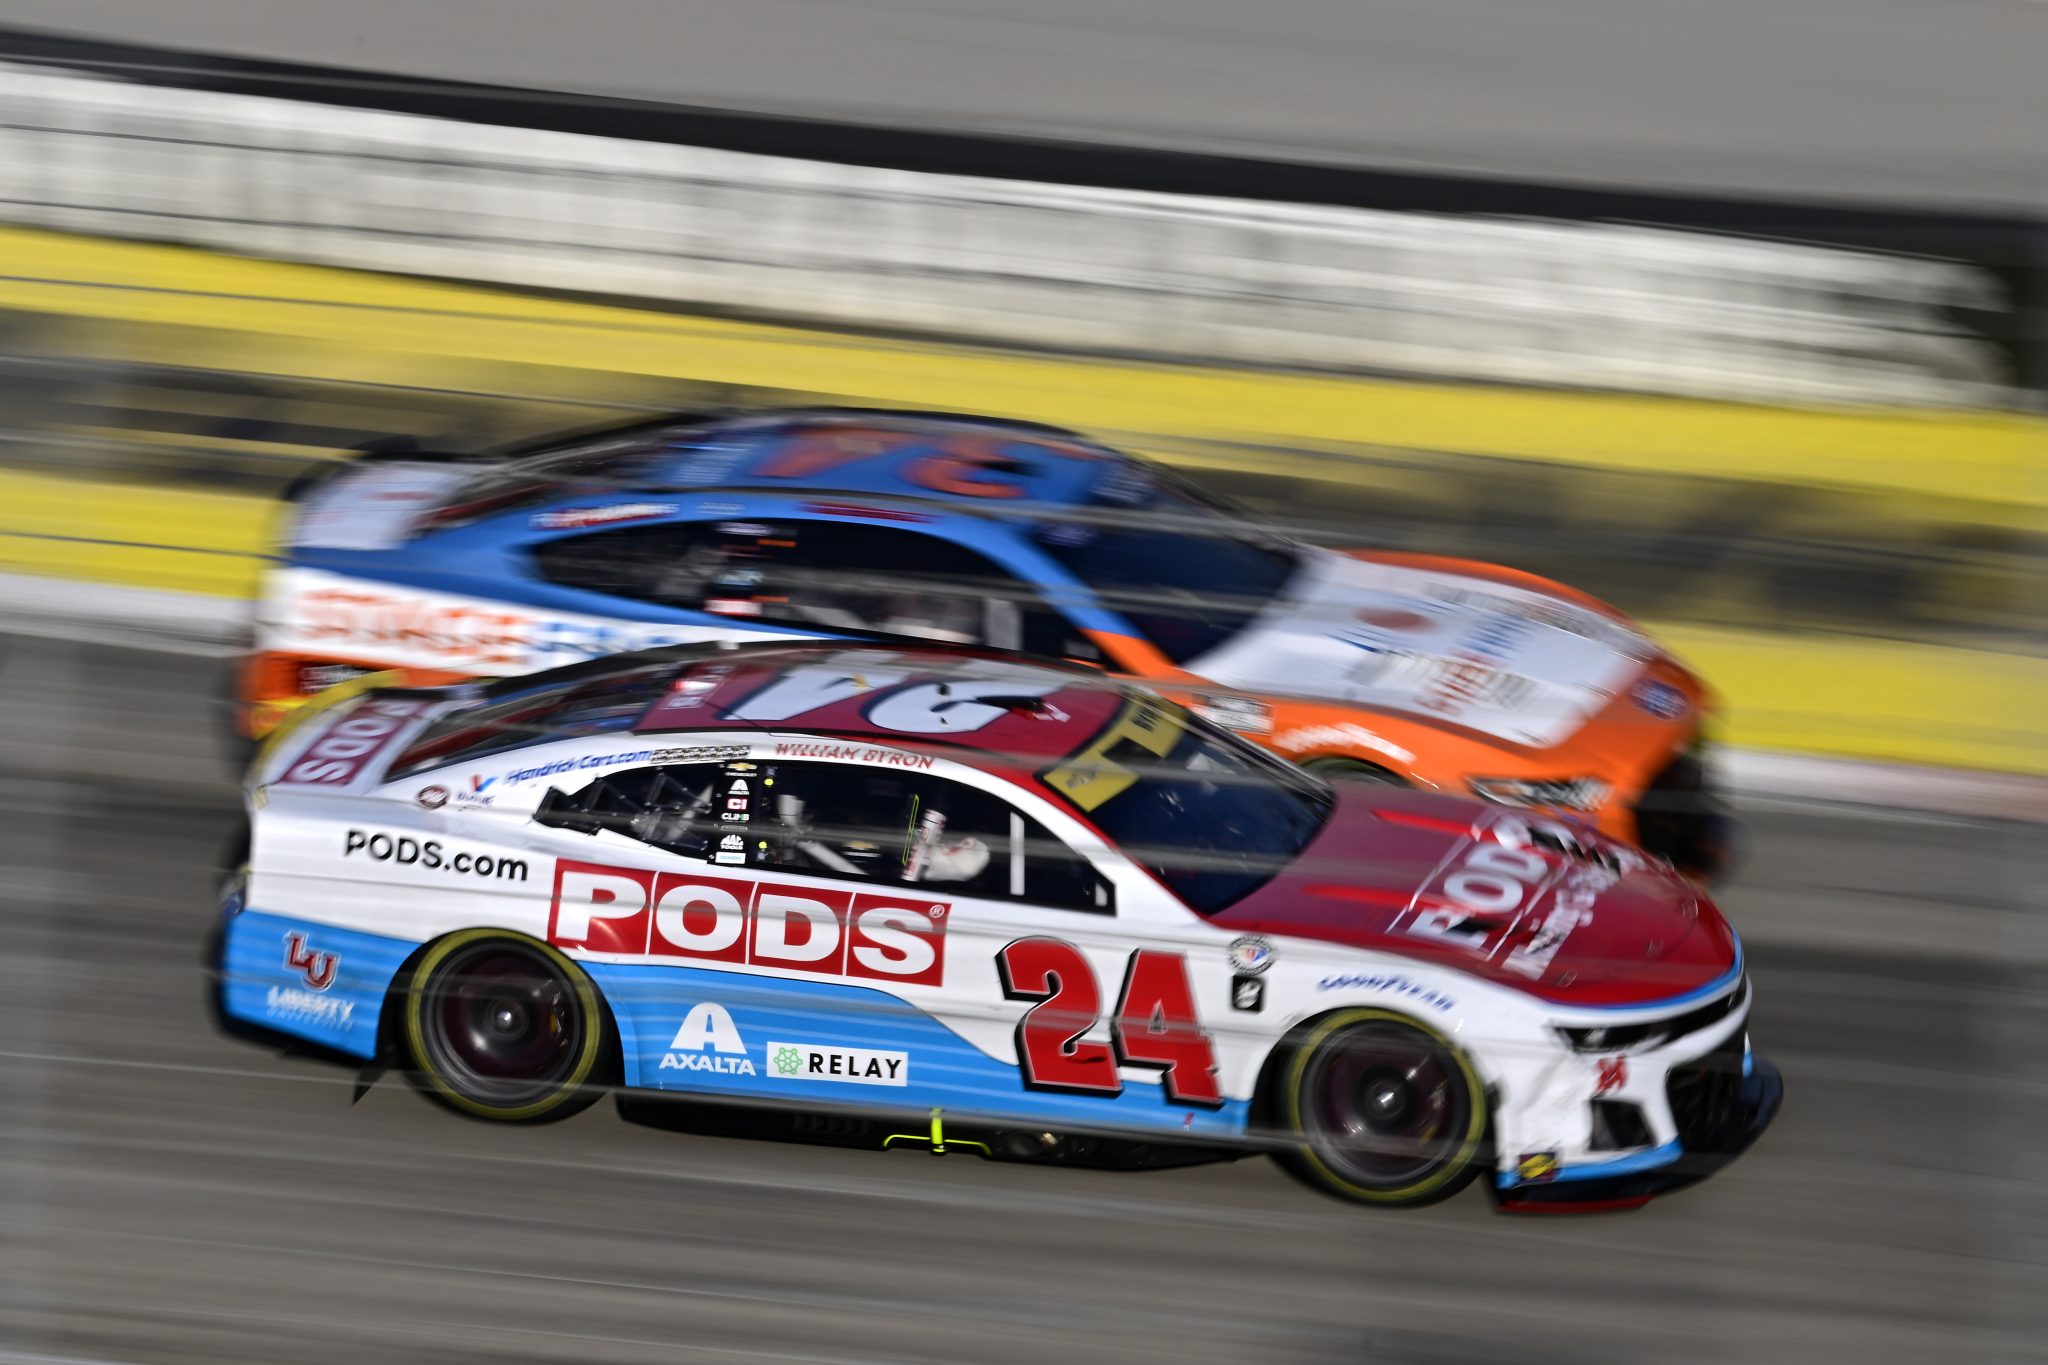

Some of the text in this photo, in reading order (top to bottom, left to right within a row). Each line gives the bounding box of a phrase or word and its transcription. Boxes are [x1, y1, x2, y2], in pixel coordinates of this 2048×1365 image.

[775, 742, 936, 769] WILLIAM BYRON
[344, 830, 528, 881] PODS.com
[555, 870, 936, 975] PODS
[995, 935, 1225, 1111] 24
[659, 1053, 756, 1076] AXALTA
[809, 1053, 902, 1079] RELAY
